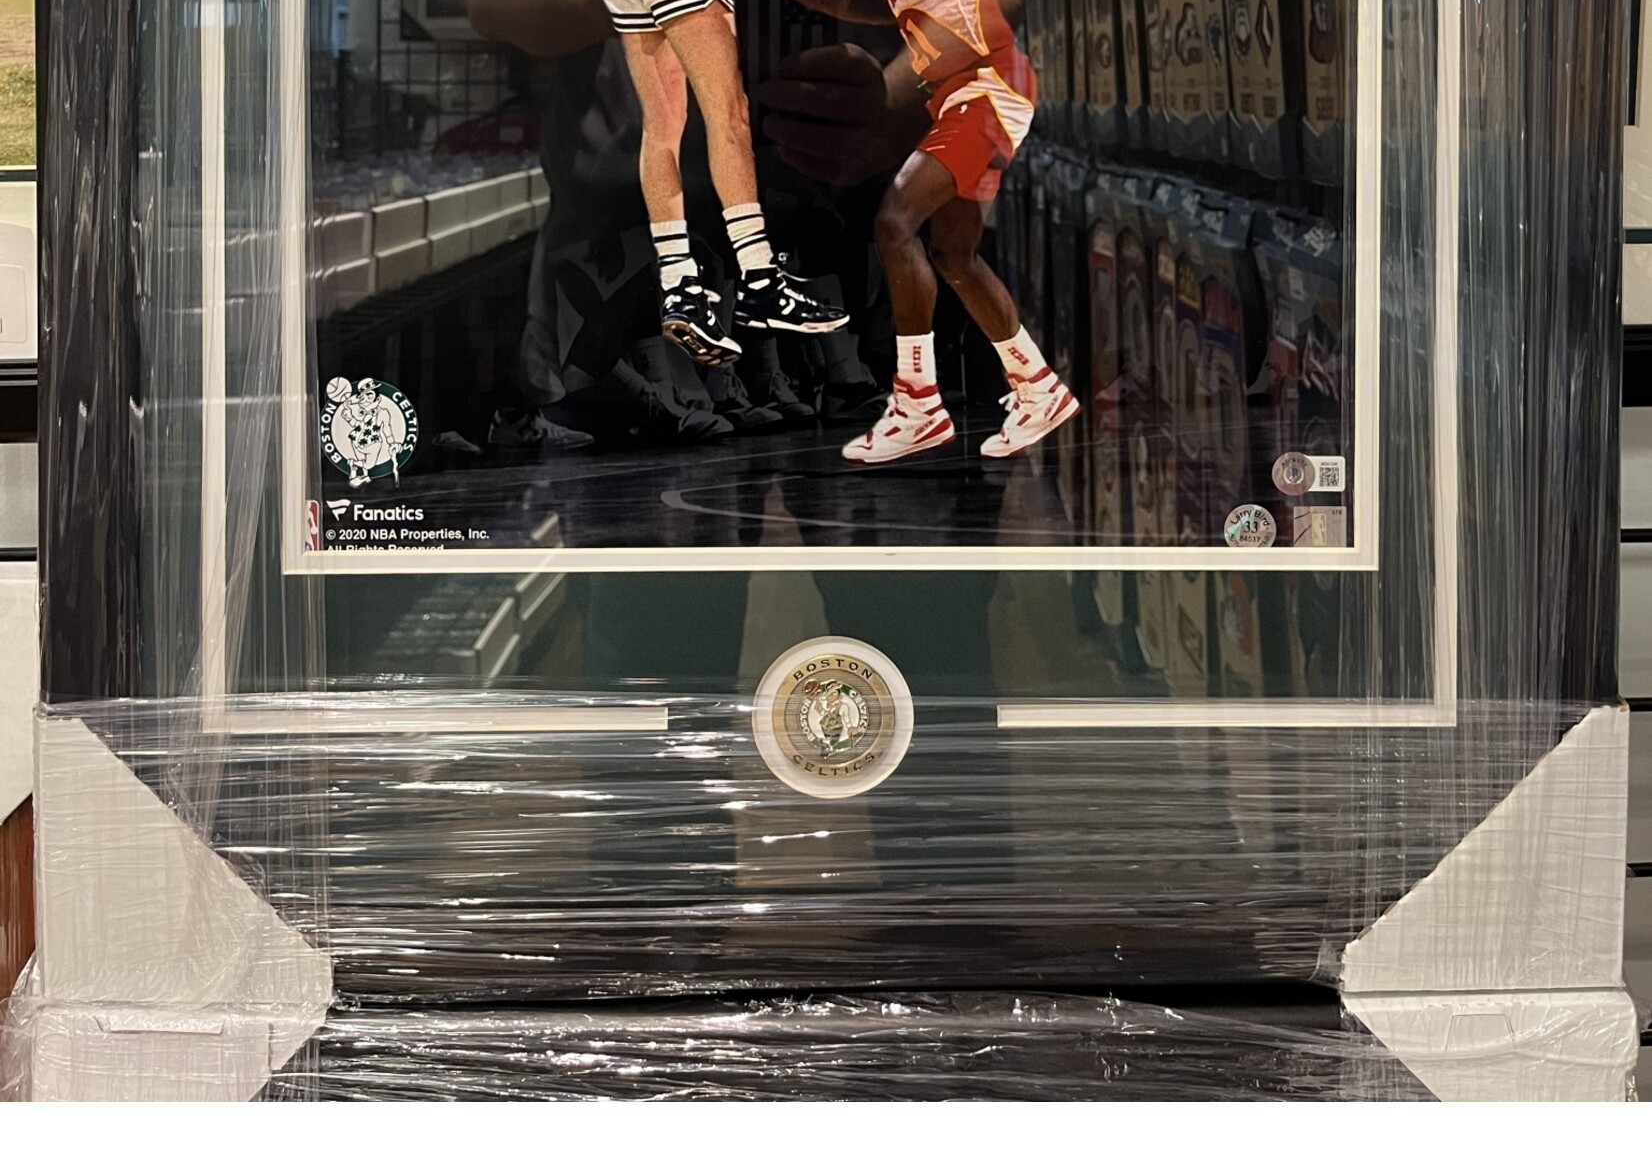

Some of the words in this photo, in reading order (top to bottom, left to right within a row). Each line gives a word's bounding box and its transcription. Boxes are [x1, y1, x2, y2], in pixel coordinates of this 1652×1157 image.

[320, 403, 342, 464] BOSTON
[392, 391, 418, 452] CELTICS
[353, 504, 424, 521] Fanatics
[1230, 509, 1252, 525] Larry
[1254, 509, 1271, 527] Bird
[326, 529, 336, 541] ©
[338, 528, 367, 541] 2020
[370, 528, 398, 541] NBA
[400, 528, 464, 542] Properties,
[468, 528, 490, 540] Inc.
[1243, 520, 1259, 534] 33
[793, 658, 873, 682] BOSTON
[800, 698, 816, 742] BOSTON
[792, 752, 876, 777] CELTICS
